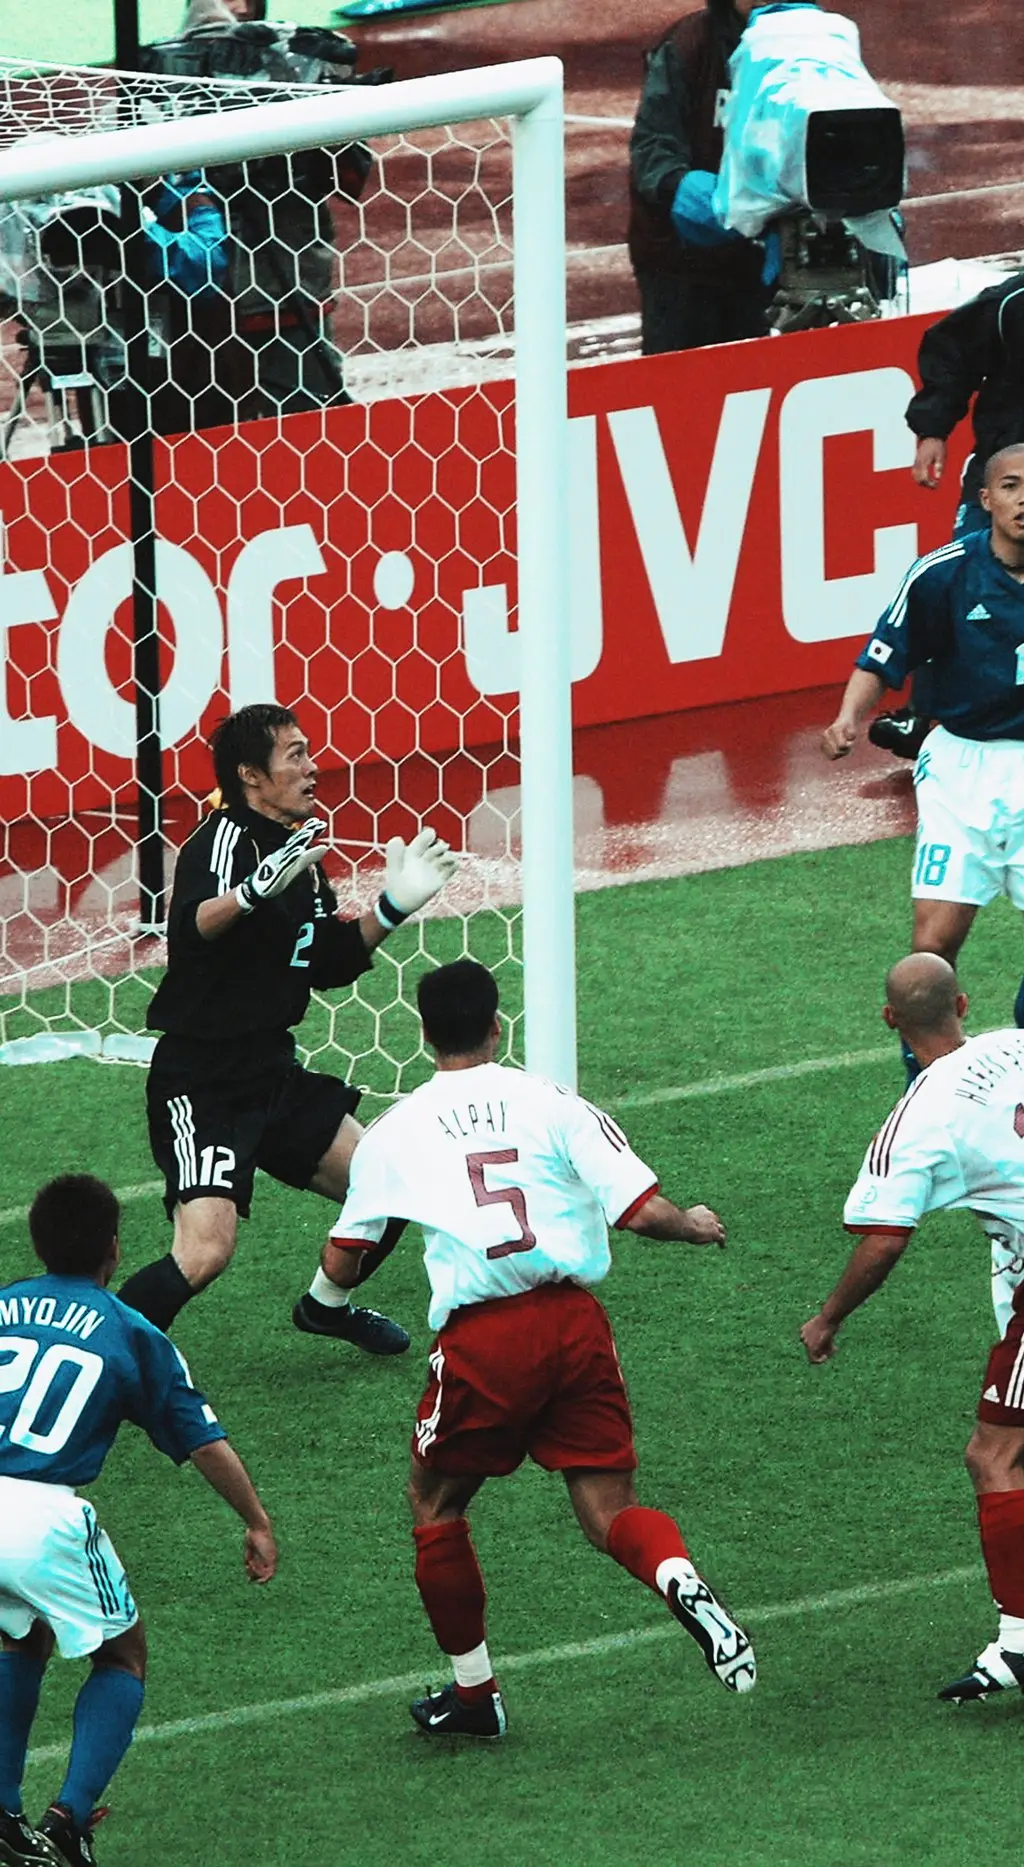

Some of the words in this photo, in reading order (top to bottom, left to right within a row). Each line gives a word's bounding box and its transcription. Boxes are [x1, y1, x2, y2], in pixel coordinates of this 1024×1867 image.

[462, 366, 919, 696] JVC
[915, 842, 952, 887] 18
[436, 1100, 507, 1140] ALPAY
[199, 1145, 236, 1189] 12
[465, 1147, 537, 1261] 5
[0, 1296, 105, 1341] MYOJIN
[0, 1335, 104, 1455] 20
